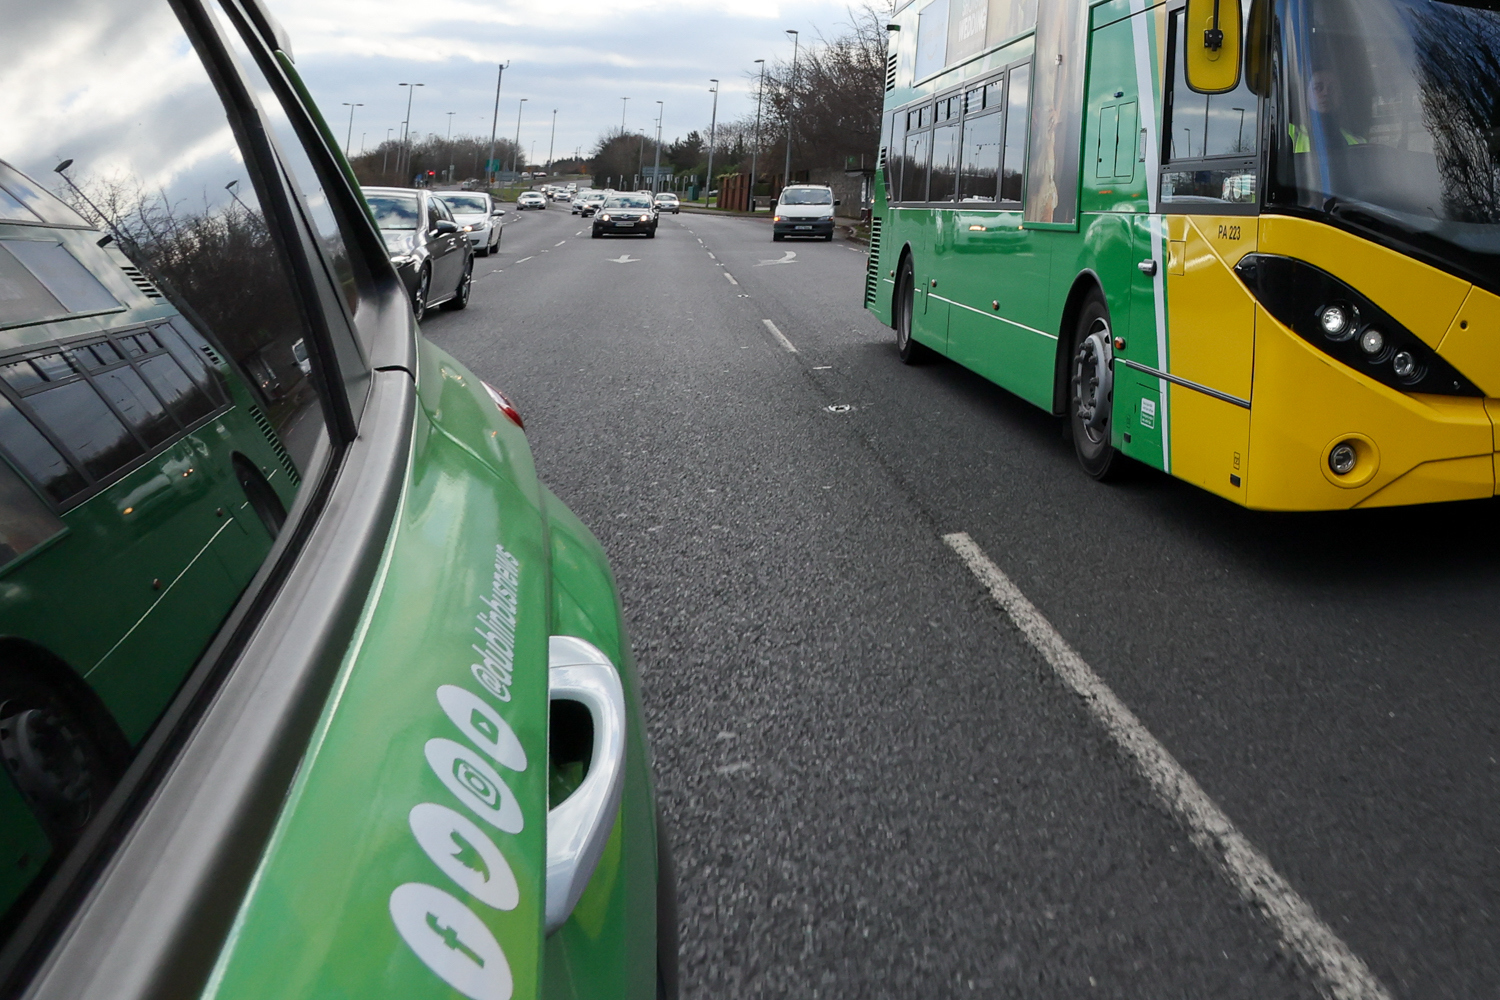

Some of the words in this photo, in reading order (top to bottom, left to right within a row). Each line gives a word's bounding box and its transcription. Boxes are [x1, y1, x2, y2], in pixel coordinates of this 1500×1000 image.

[1218, 225, 1227, 239] PA
[1229, 226, 1240, 240] 223
[470, 544, 520, 702] @dublinbusnews
